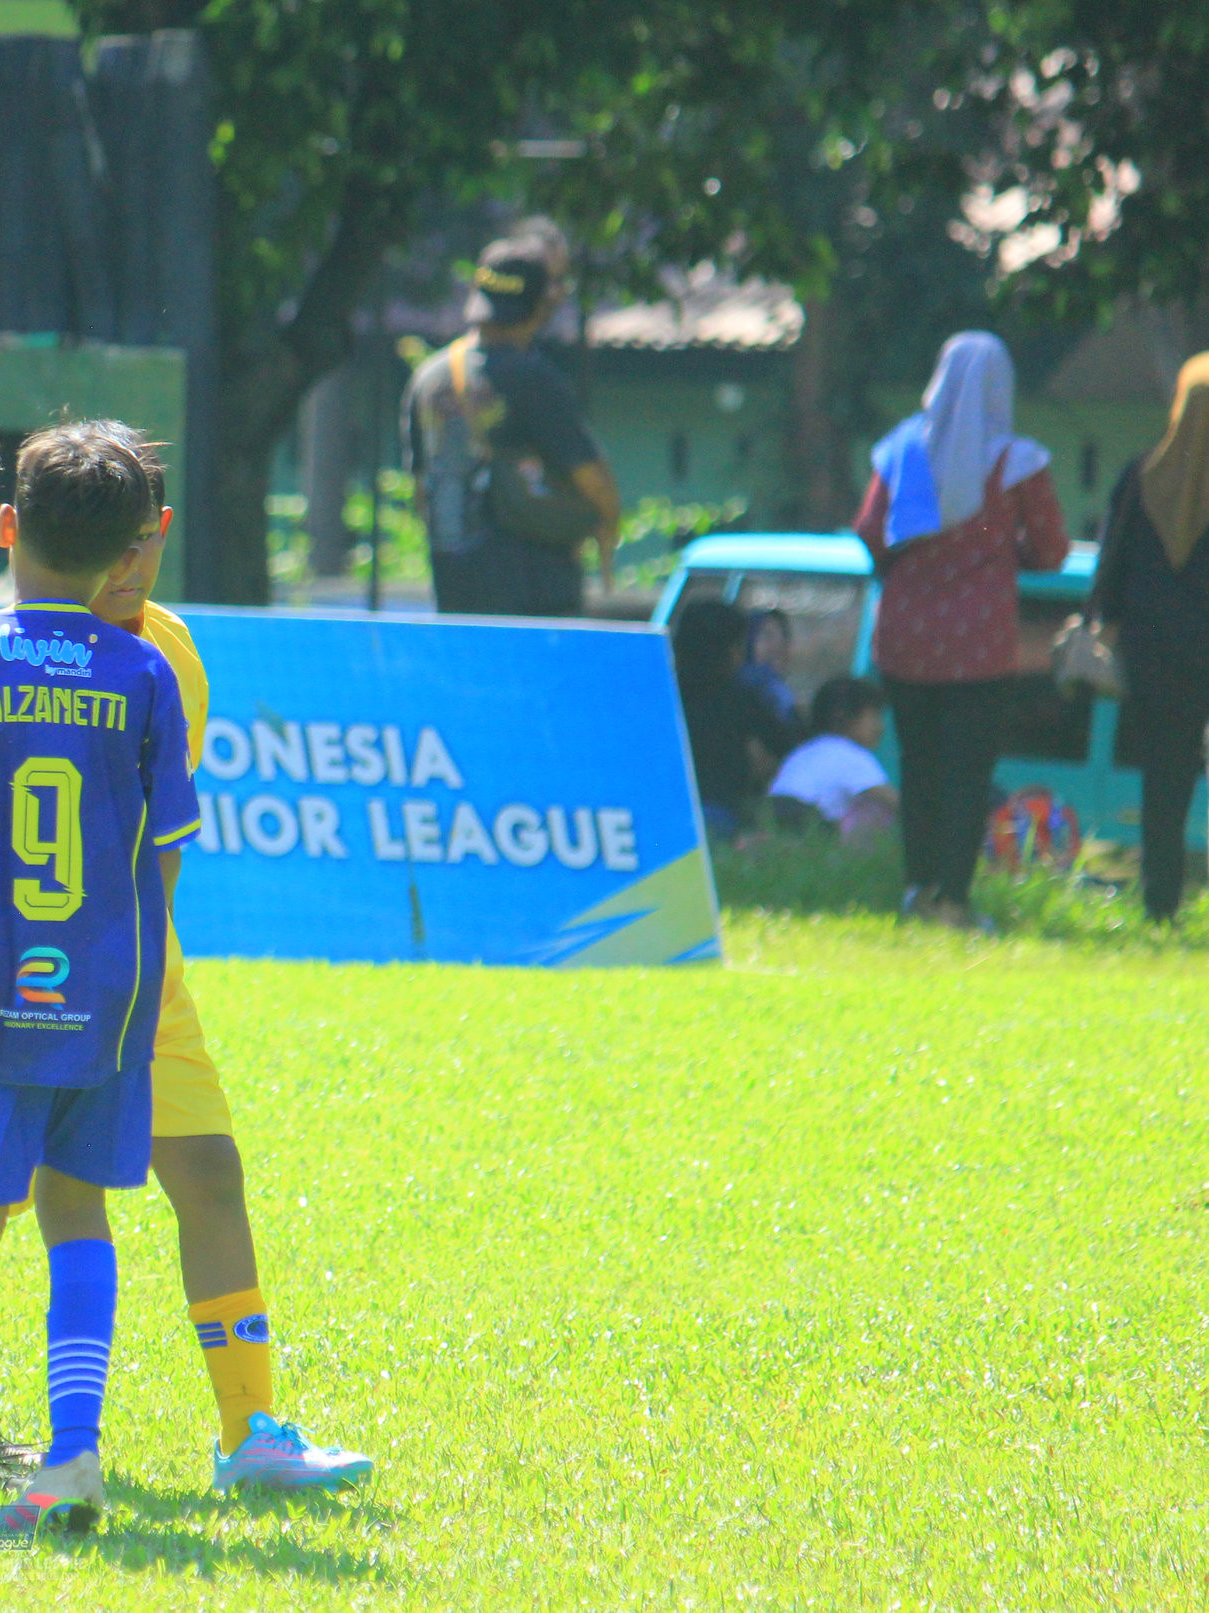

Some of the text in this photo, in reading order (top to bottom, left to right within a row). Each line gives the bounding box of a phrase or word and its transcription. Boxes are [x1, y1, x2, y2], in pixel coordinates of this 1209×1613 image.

[201, 717, 465, 789] ONESIA
[8, 756, 88, 922] 9
[367, 797, 638, 872] LEAGUE
[21, 1012, 59, 1021] OPTICAL
[60, 1013, 91, 1022] GROUP
[37, 1023, 84, 1031] EXCELLENCE
